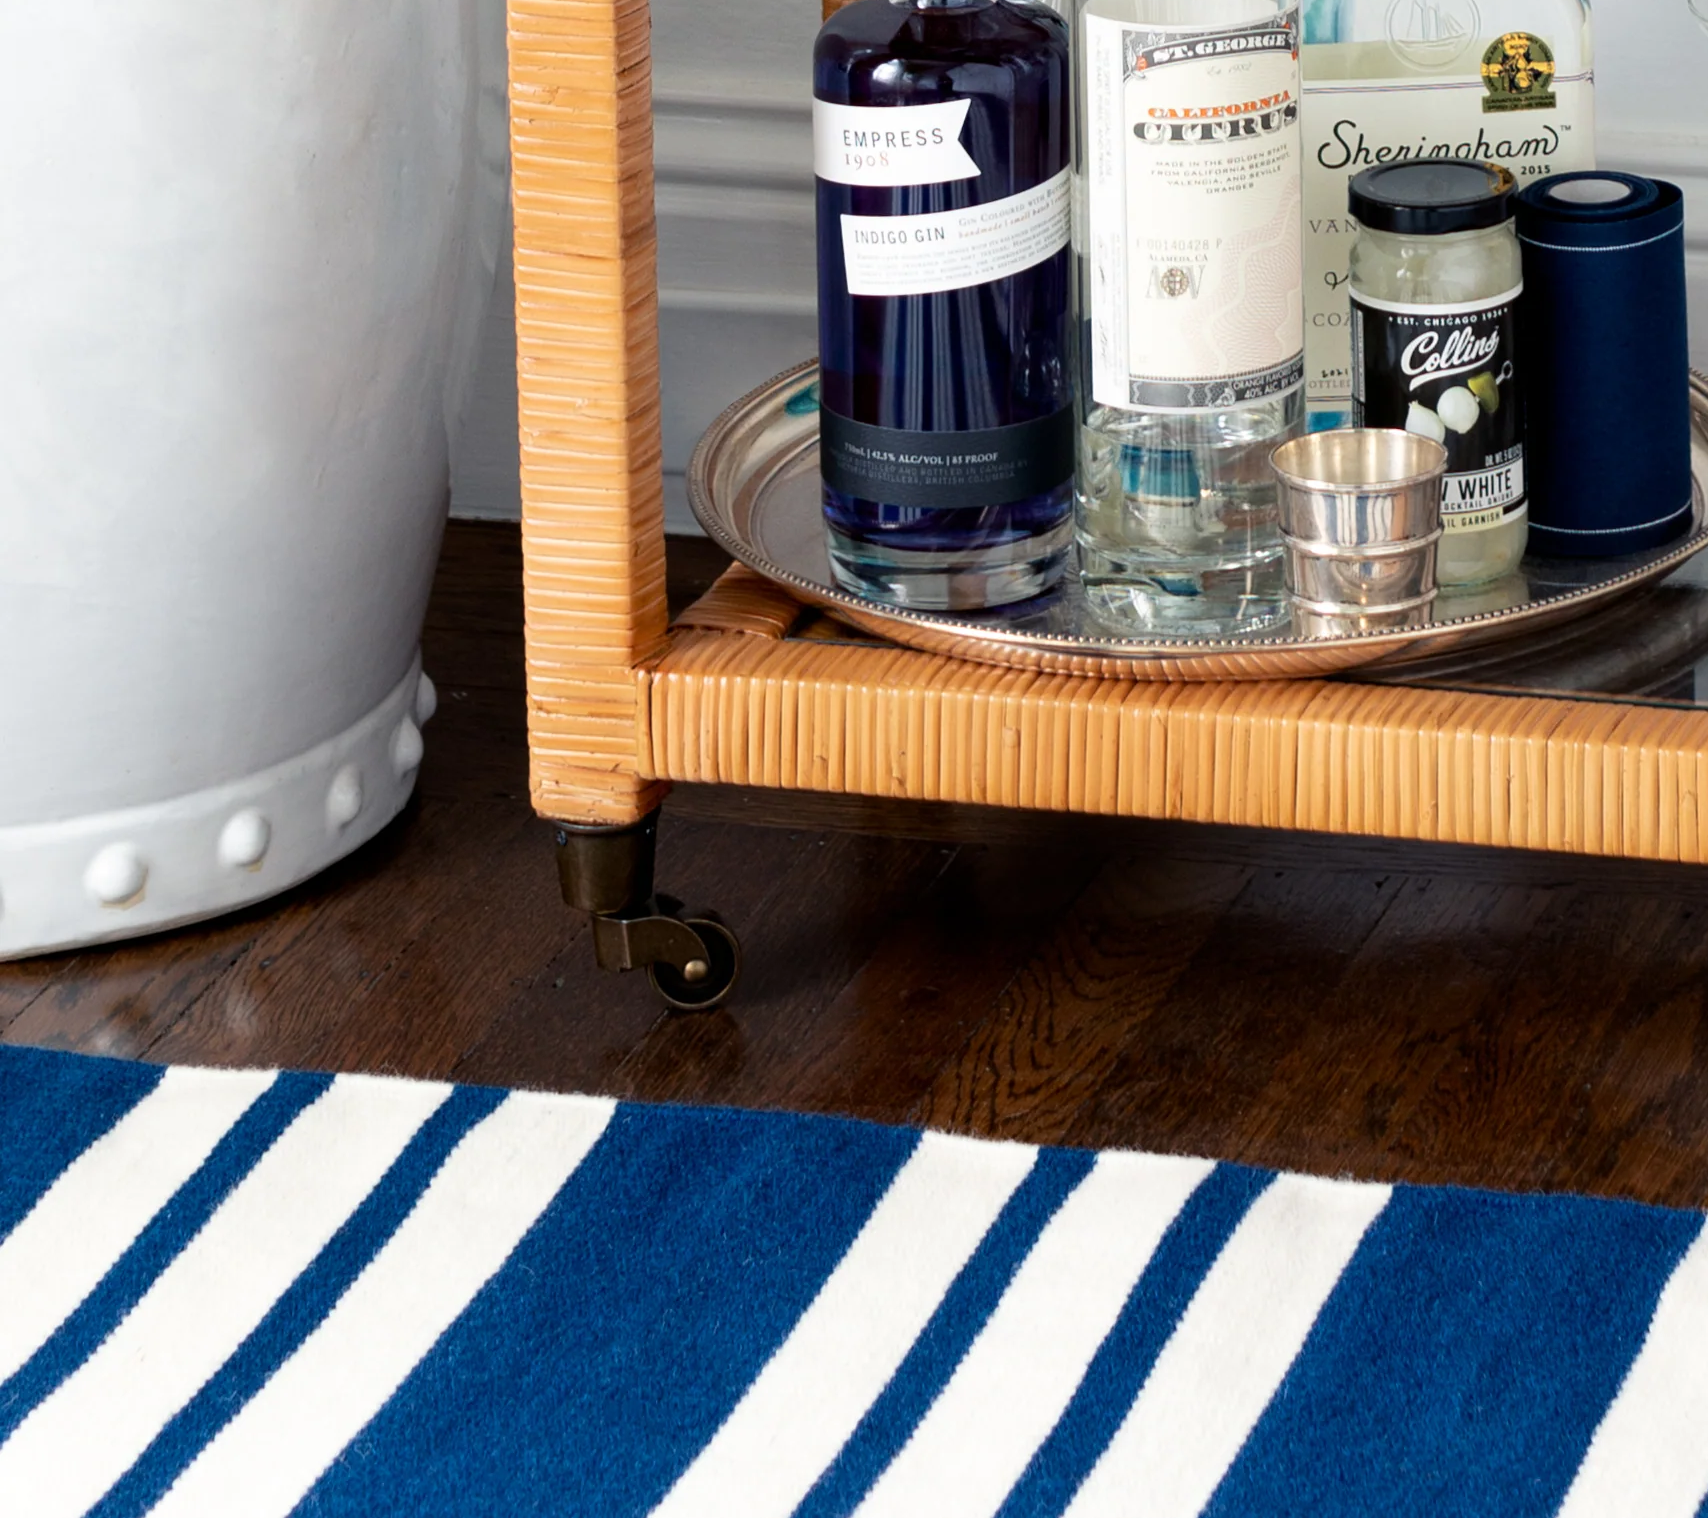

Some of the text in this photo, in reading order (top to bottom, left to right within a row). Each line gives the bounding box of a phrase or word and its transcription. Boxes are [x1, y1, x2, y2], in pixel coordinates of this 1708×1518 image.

[1148, 90, 1291, 119] CALIFORNIA
[1133, 100, 1298, 145] CITRUS
[843, 128, 944, 148] EMPRESS
[1318, 120, 1559, 169] Sheringham
[845, 150, 889, 171] 1908
[1204, 159, 1223, 167] THE
[1227, 152, 1265, 165] GOLDEN
[1151, 169, 1180, 177] FROM
[1183, 165, 1246, 177] CALIFORNIA
[1226, 173, 1247, 183] AND
[1521, 165, 1551, 176] 2015
[1206, 182, 1254, 195] ORANGES
[855, 226, 945, 245] INDIGO GIN
[1397, 316, 1419, 326] EST.
[1424, 314, 1478, 326] CHICAGO
[1401, 326, 1499, 376] Collins
[898, 453, 944, 466] ALC/VOL
[965, 451, 998, 465] PROOF
[925, 474, 965, 486] BRITISH
[1458, 468, 1511, 501] WHITE
[1440, 500, 1483, 511] OCKTAIL
[1461, 511, 1500, 527] GARNISH
